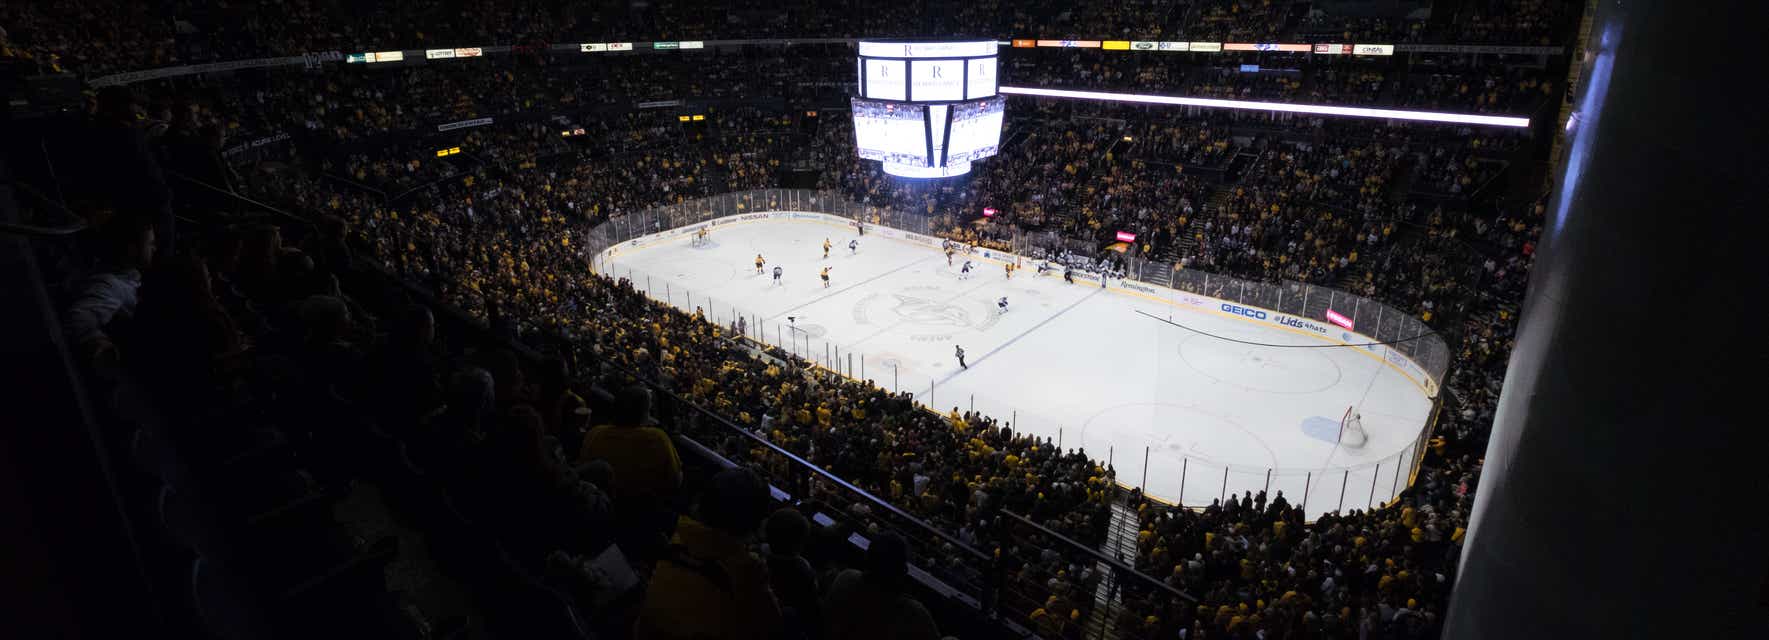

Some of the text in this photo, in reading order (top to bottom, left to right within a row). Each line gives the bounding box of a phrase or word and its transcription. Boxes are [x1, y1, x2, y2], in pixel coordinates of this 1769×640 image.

[905, 45, 912, 56] R
[881, 65, 888, 77] R
[932, 65, 942, 78] R
[1221, 303, 1266, 320] GEICO
